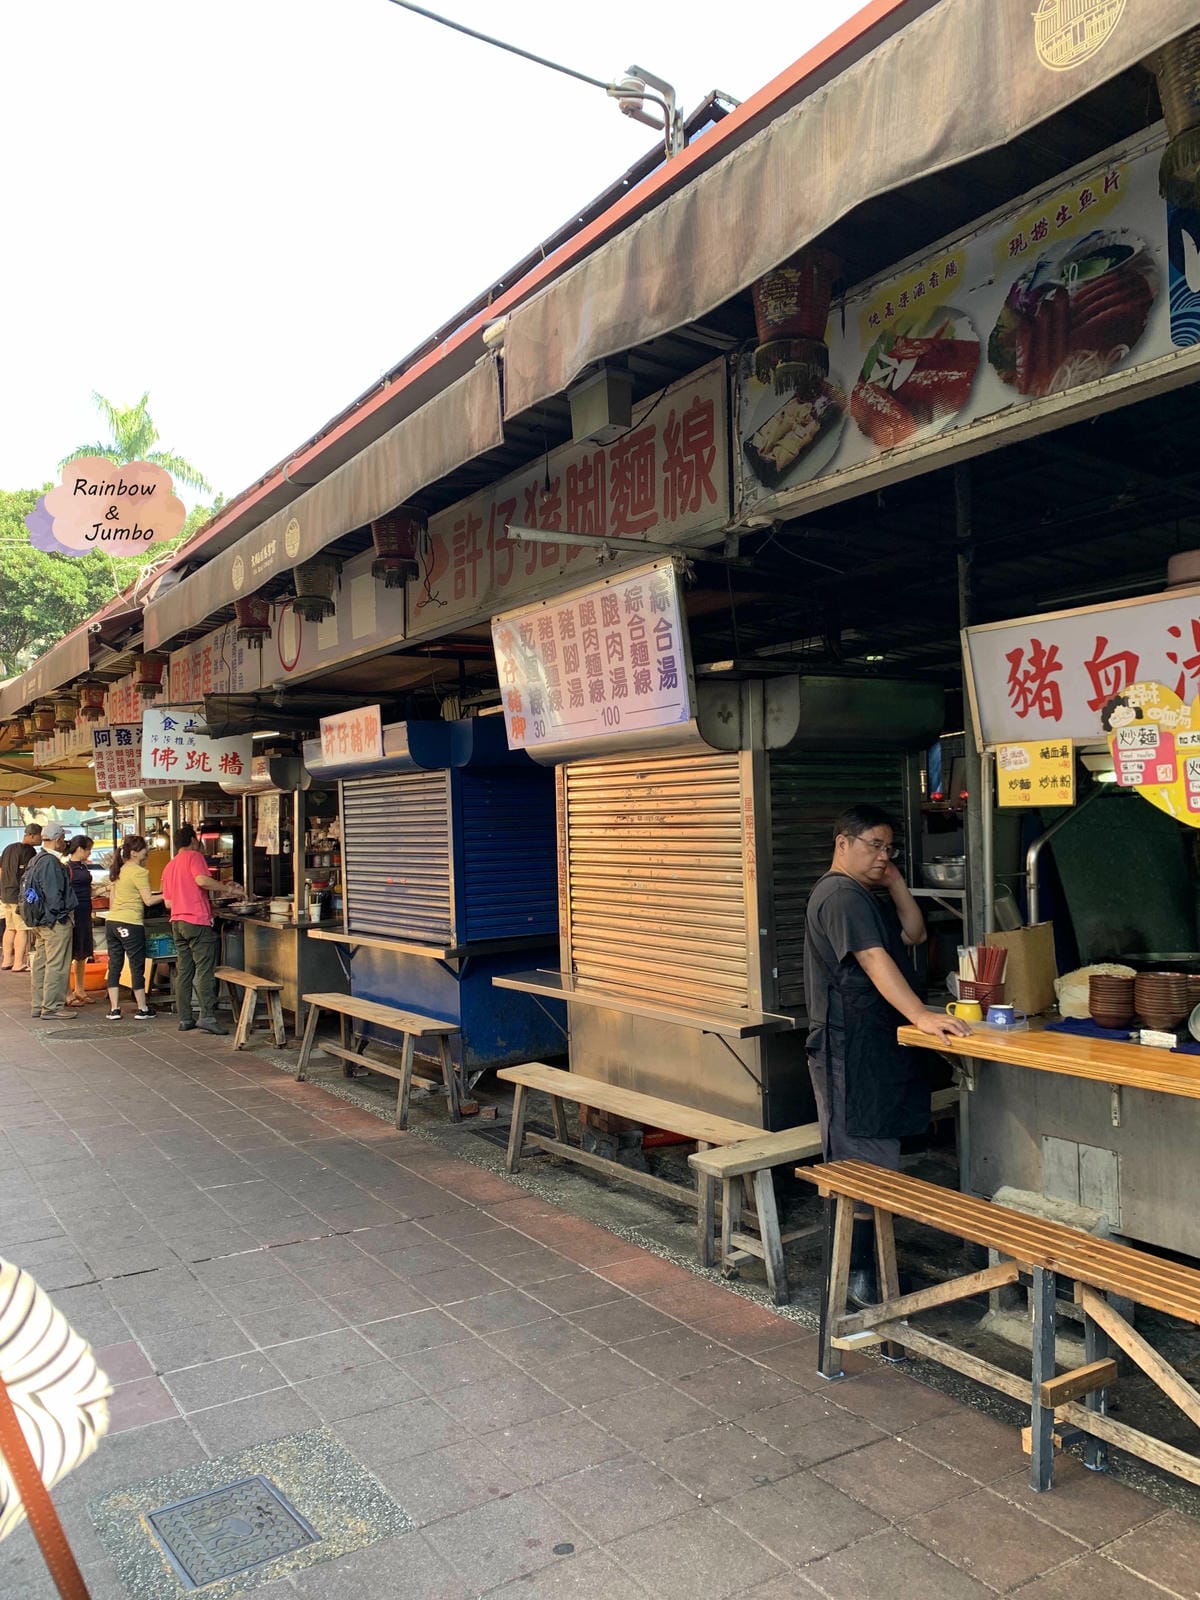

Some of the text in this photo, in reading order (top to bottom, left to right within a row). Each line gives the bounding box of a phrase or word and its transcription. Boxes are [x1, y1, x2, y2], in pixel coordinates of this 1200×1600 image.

[1008, 169, 1122, 257] 現撈生魚片
[578, 600, 607, 706] 腿肉麵線
[600, 593, 629, 700] 腿肉湯
[624, 585, 654, 696] 綜合麵線
[649, 580, 678, 691] 綜合湯
[533, 720, 546, 739] 30
[601, 705, 621, 727] 100
[1119, 728, 1158, 747] 炒麵
[150, 747, 245, 776] 佛跳牆
